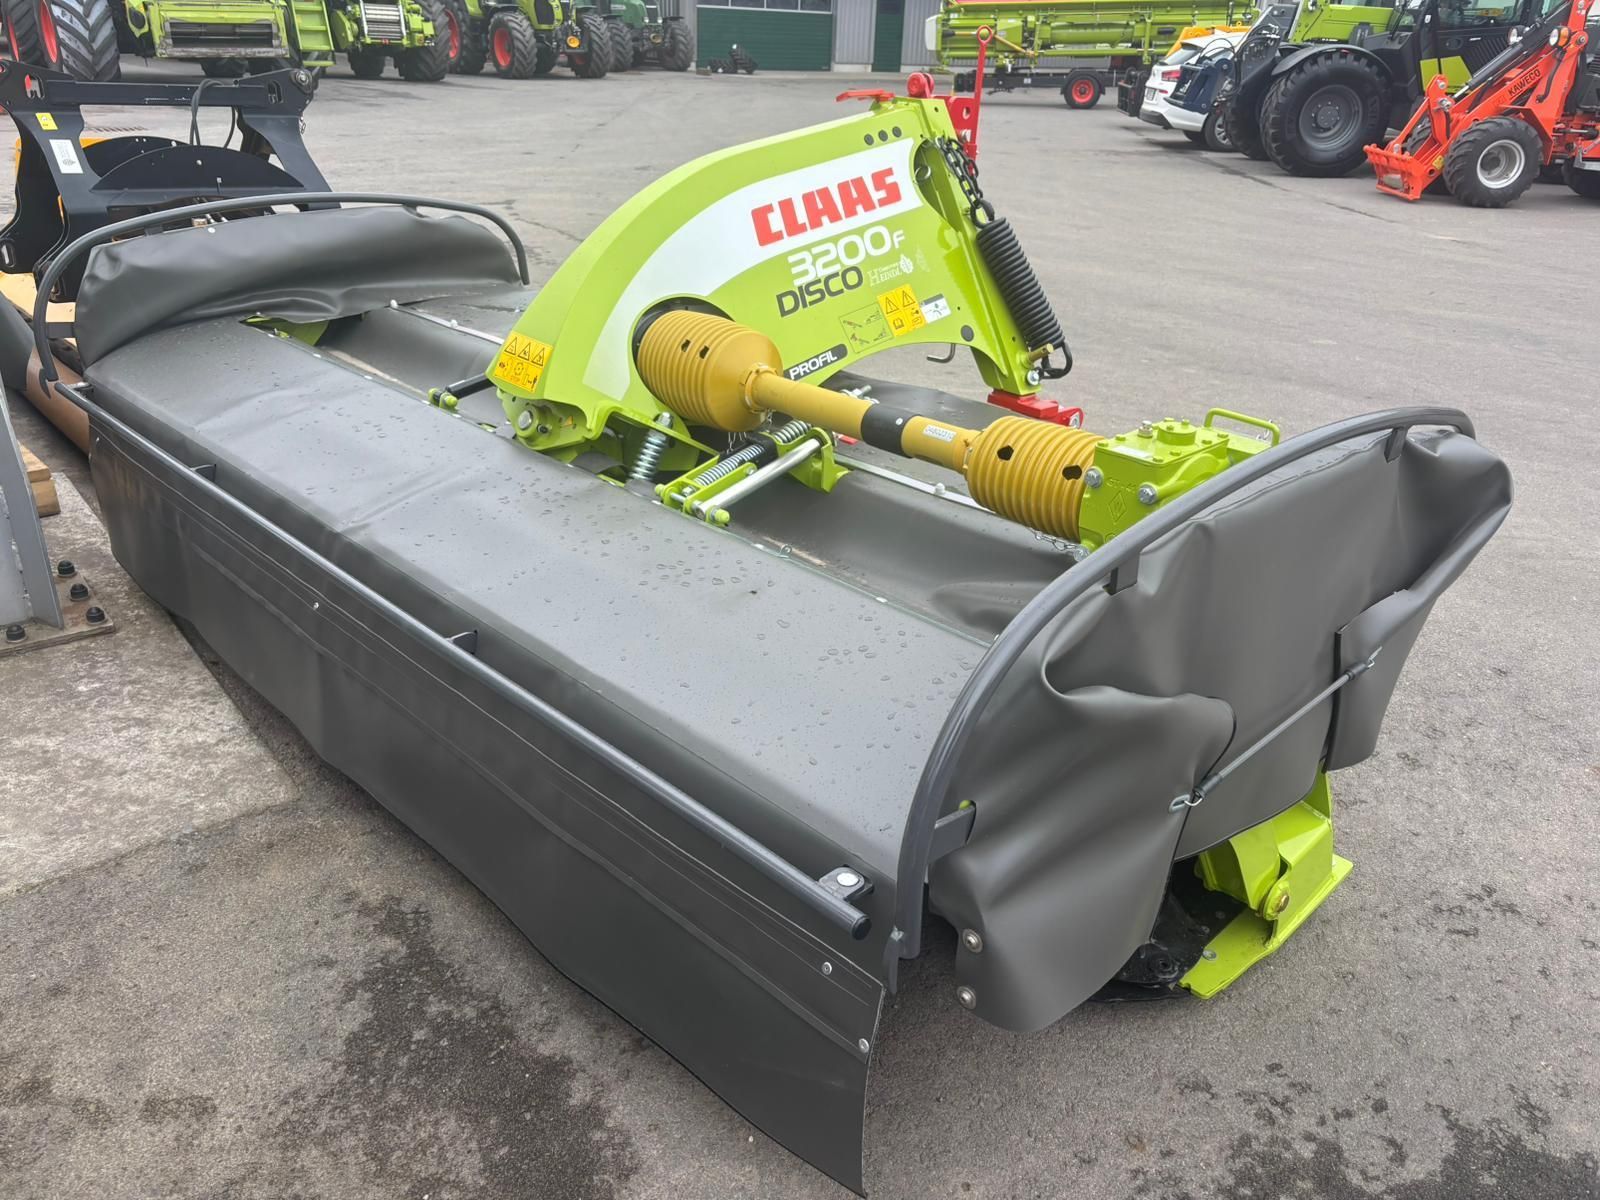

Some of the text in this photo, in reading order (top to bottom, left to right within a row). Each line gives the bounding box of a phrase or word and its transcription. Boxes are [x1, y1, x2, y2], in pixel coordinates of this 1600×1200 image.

[1508, 68, 1541, 96] KAWECO
[751, 167, 902, 246] CLAAS
[776, 266, 864, 318] DISCO
[789, 350, 838, 380] PROFIL
